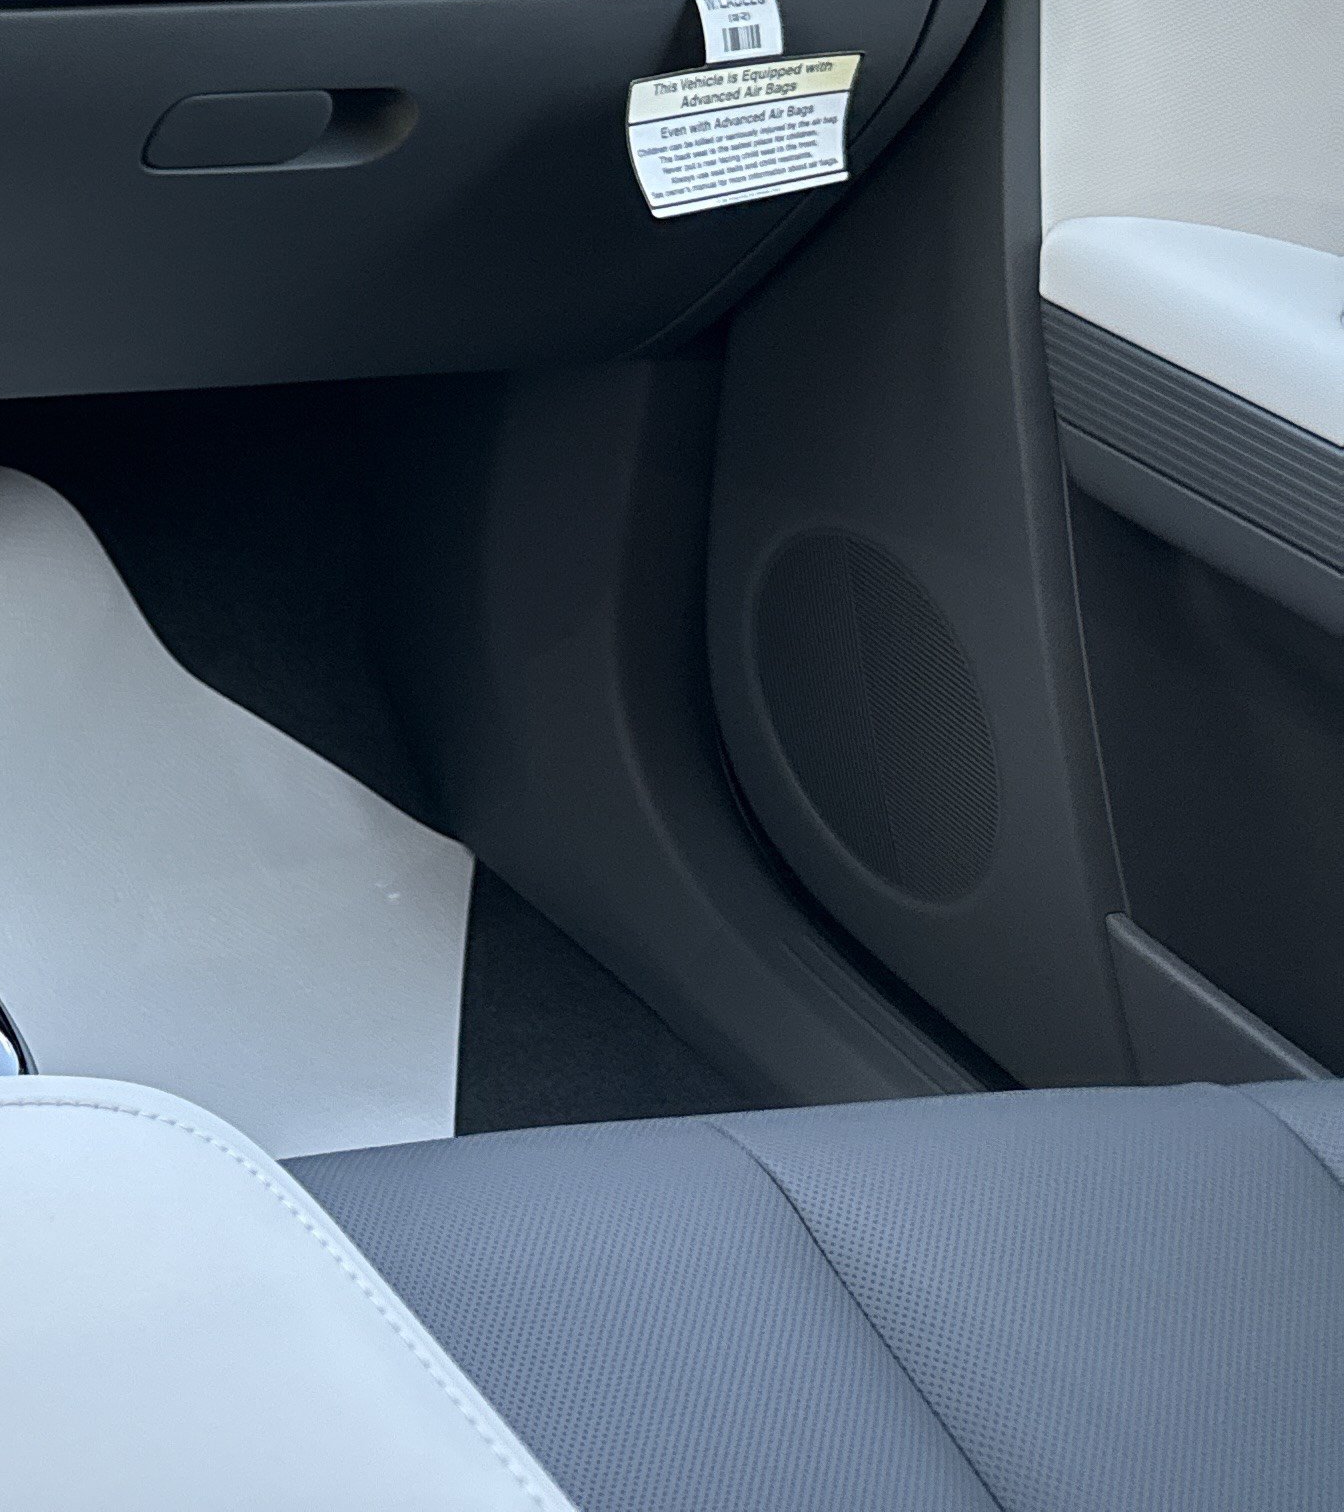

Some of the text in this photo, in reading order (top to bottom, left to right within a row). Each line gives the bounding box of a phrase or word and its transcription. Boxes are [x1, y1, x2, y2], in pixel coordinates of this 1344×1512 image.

[654, 62, 833, 96] This Vehicle is Equipped with
[681, 81, 797, 109] Advanced Air Bags
[661, 104, 814, 139] Even with Advanced Air Bags
